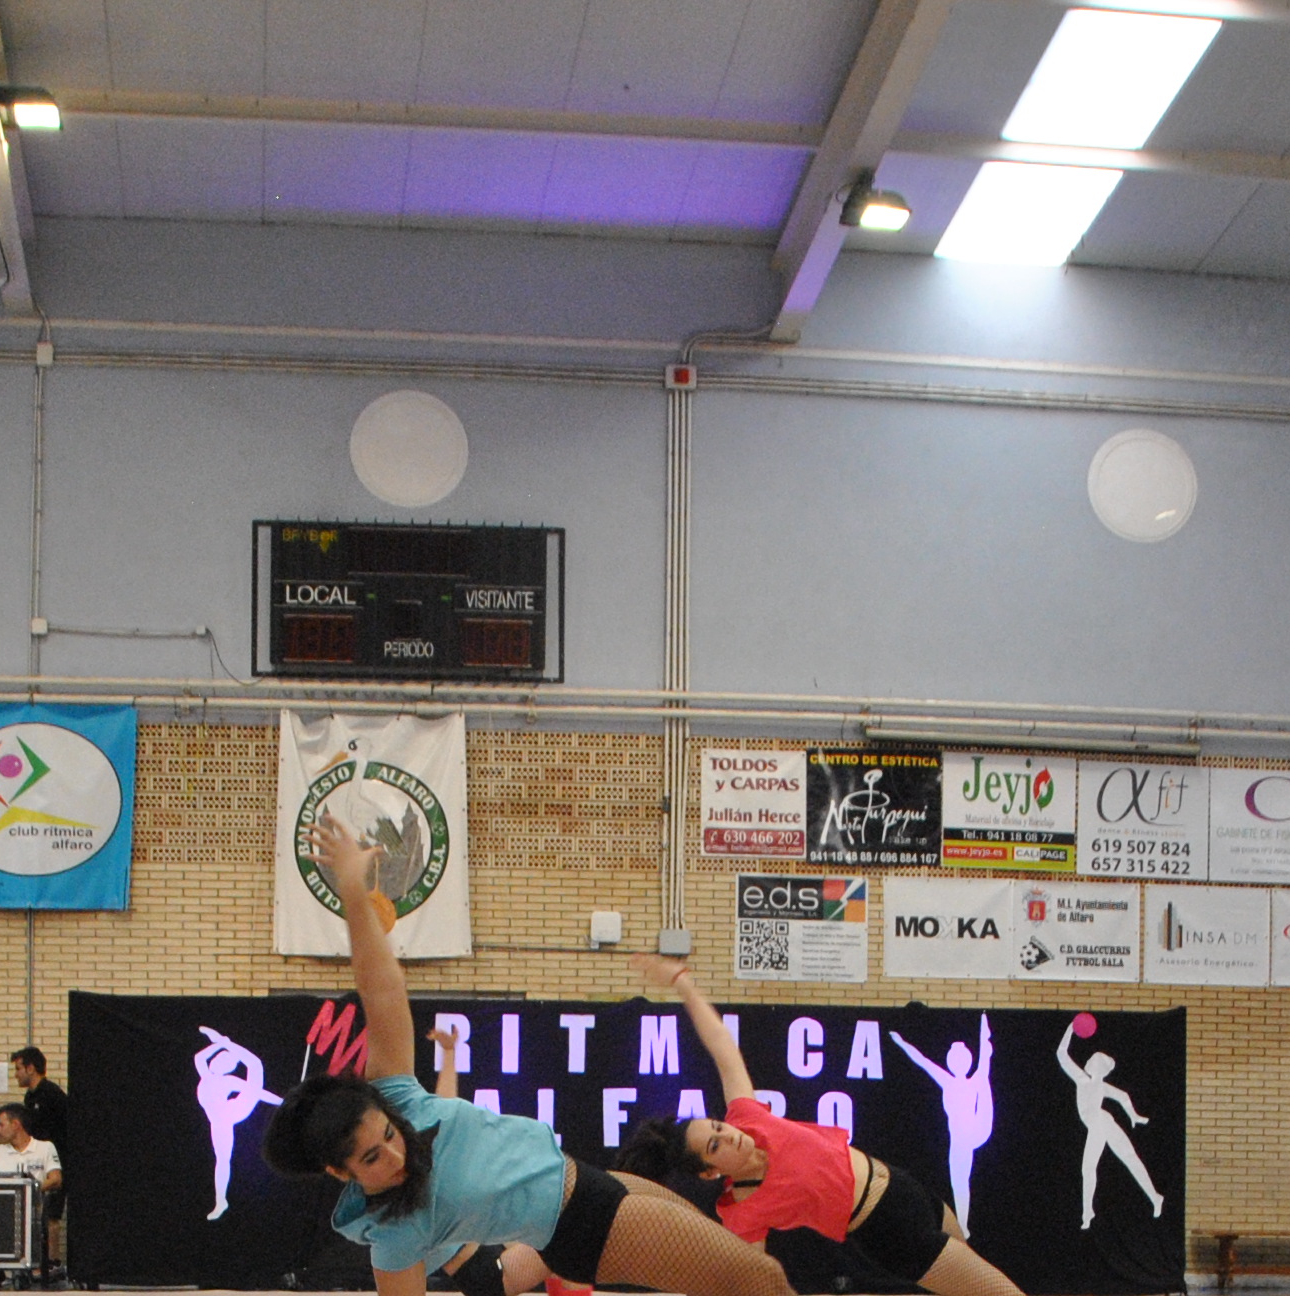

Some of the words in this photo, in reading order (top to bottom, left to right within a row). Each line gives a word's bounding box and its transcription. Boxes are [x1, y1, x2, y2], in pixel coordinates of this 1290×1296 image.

[285, 585, 356, 605] LOCAL
[465, 590, 534, 610] VISITANTE
[384, 641, 434, 658] PERIODO
[710, 757, 778, 772] TOLDOS
[810, 755, 859, 765] CENTRO
[862, 756, 878, 766] DE
[881, 755, 939, 767] ESTÉTICA
[715, 780, 725, 792] y
[730, 777, 800, 791] CARPAS
[963, 756, 1054, 815] Jeyjo
[708, 807, 752, 822] Julián
[758, 808, 801, 823] Herce
[965, 814, 992, 824] Material
[993, 816, 1000, 824] de
[9, 825, 38, 837] club
[963, 830, 983, 840] Tel.:
[987, 831, 1005, 840] 941
[1010, 832, 1022, 841] 18
[1025, 832, 1038, 842] 08
[1041, 834, 1054, 842] 77
[1216, 827, 1258, 839] GABINETE
[1260, 828, 1271, 840] DE
[51, 839, 93, 850] alfaro
[306, 870, 341, 911] CLUB
[377, 766, 435, 811] ALFARO
[723, 831, 746, 844] 630
[751, 831, 773, 844] 466
[777, 832, 800, 845] 202
[947, 848, 1003, 857] www.jeyjo.es
[1092, 838, 1121, 853] 619
[1127, 840, 1156, 855] 507
[1161, 841, 1190, 857] 824
[810, 851, 827, 861] 941
[832, 851, 842, 861] 18
[860, 852, 871, 862] 88
[900, 853, 917, 863] 884
[920, 854, 937, 864] 167
[1091, 858, 1121, 872] 657
[1127, 859, 1155, 873] 315
[1161, 861, 1190, 875] 422
[743, 881, 819, 911] e.d.s
[1057, 898, 1072, 909] M.I.
[1076, 898, 1128, 911] Ayuntamiento
[1057, 913, 1066, 922] de
[1069, 912, 1094, 923] Alfaro
[1186, 931, 1227, 944] INSA
[1233, 932, 1257, 945] DM
[1060, 945, 1074, 955] C.D.
[1076, 946, 1131, 955] GRACCURRIS
[1066, 957, 1100, 967] FUTBOL
[1102, 958, 1124, 967] SALA
[1204, 958, 1254, 968] Energética
